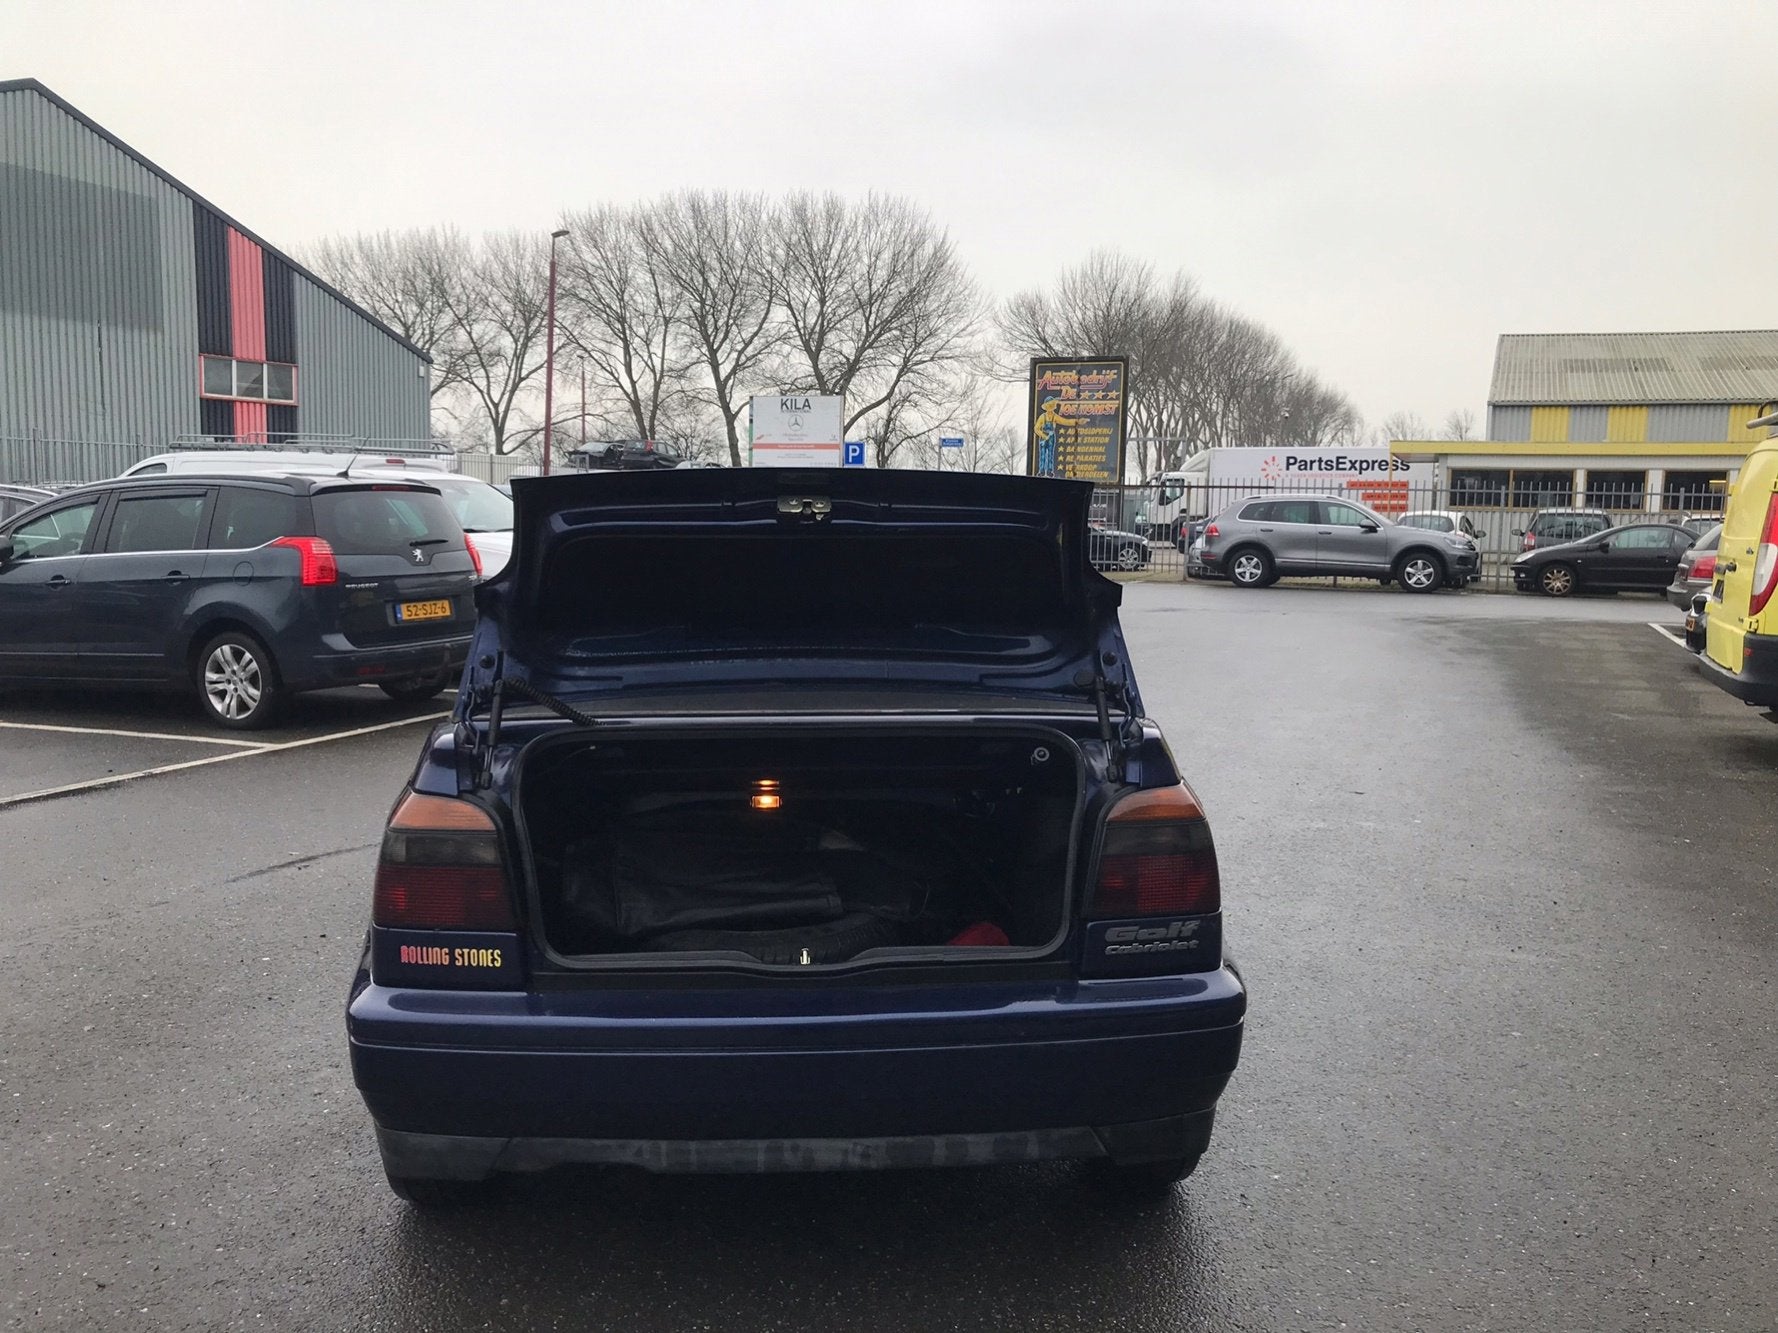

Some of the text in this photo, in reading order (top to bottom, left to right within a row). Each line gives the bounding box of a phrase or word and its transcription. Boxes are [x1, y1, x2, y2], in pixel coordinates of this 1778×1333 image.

[1037, 369, 1117, 390] Autobedrijf
[780, 398, 812, 410] KILA
[1065, 436, 1110, 444] APK STATION
[848, 445, 860, 464] P
[1285, 456, 1411, 475] PartsExpress
[406, 602, 447, 617] 52-SJZ-6
[1105, 920, 1201, 942] Golf
[400, 945, 502, 968] ROLLING STONES
[1105, 940, 1200, 955] Cabriolet
